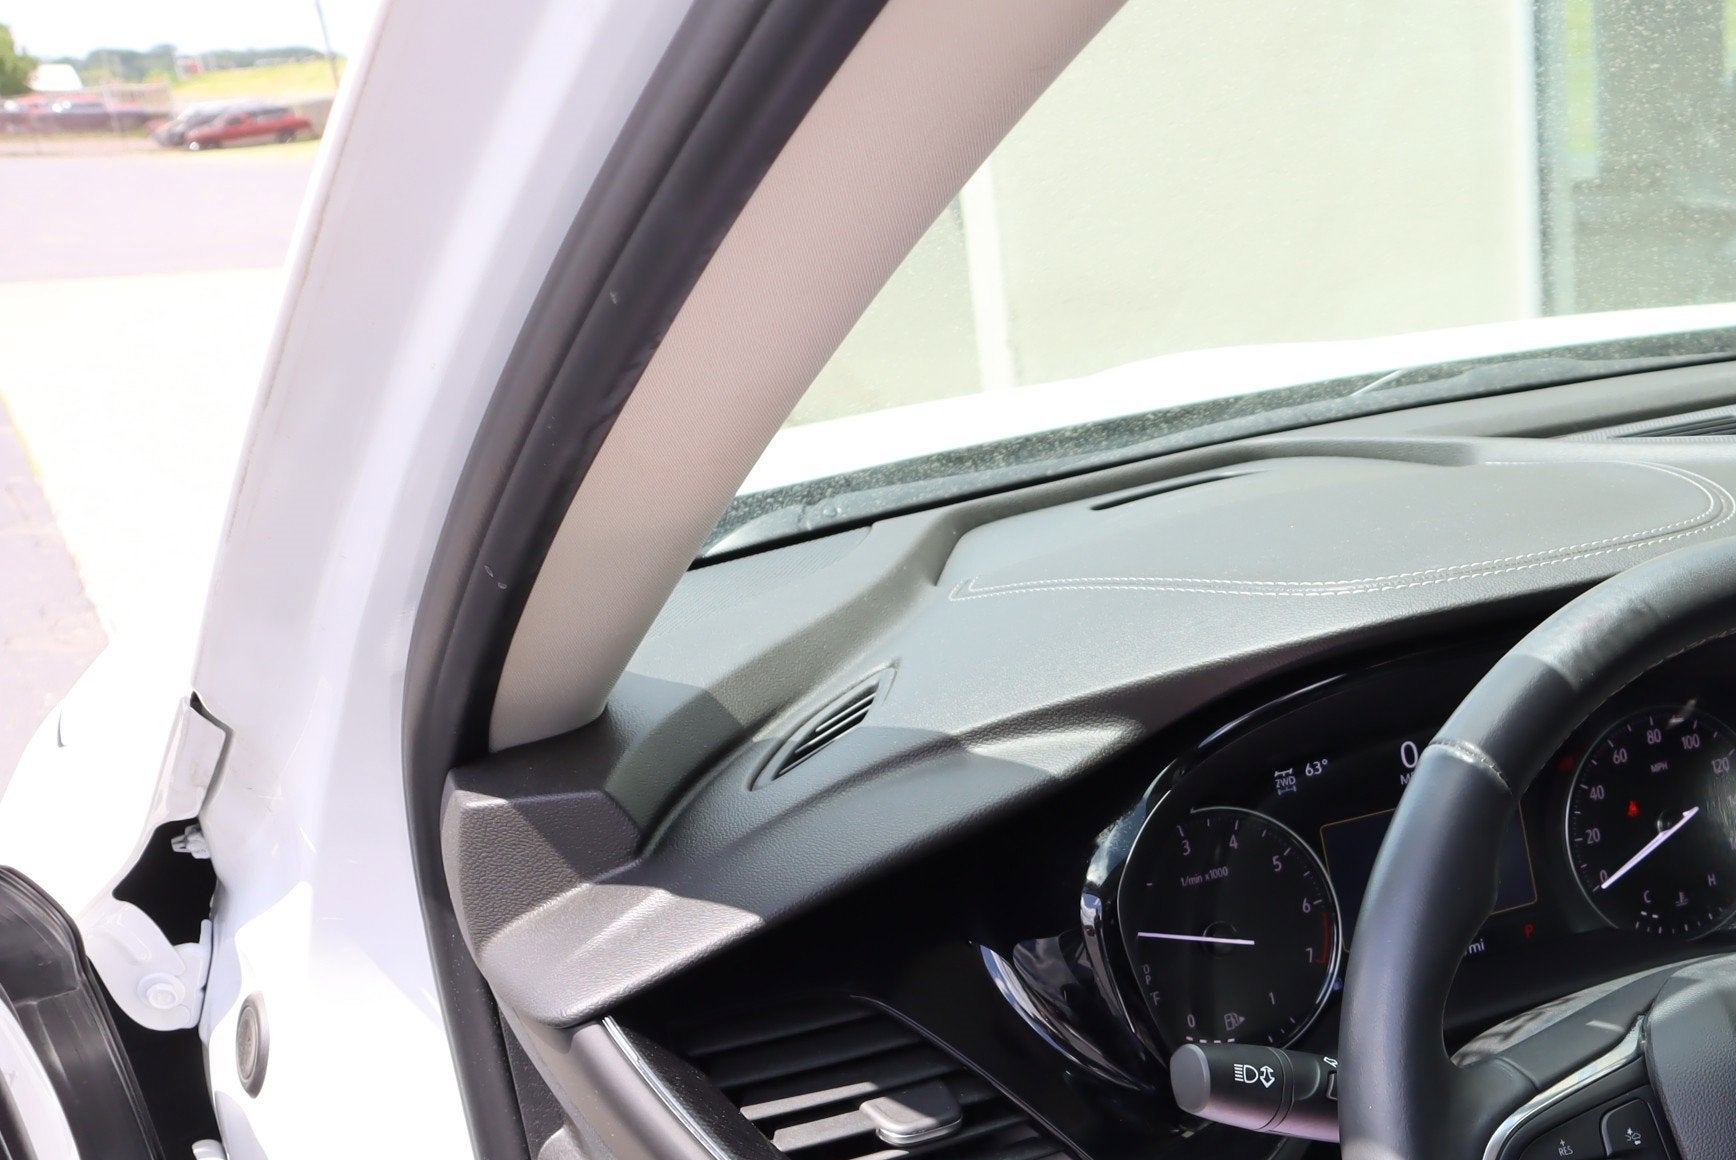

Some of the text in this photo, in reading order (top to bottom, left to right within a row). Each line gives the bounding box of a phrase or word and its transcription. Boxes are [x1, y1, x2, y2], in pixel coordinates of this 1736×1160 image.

[1646, 728, 1662, 745] 80
[1681, 733, 1700, 751] 100
[1400, 740, 1419, 769] 0
[1612, 747, 1629, 765] 60
[1650, 761, 1669, 775] MPH
[1711, 757, 1730, 775] 120
[1589, 784, 1606, 801] 40
[1228, 833, 1239, 850] 4
[1586, 827, 1601, 844] 20
[1182, 839, 1192, 856] 3
[1272, 855, 1282, 872] 5
[1707, 873, 1717, 887] H
[1301, 896, 1312, 913] 6
[1643, 889, 1653, 904] C
[1305, 946, 1314, 963] 7
[1557, 1145, 1574, 1158] RES
